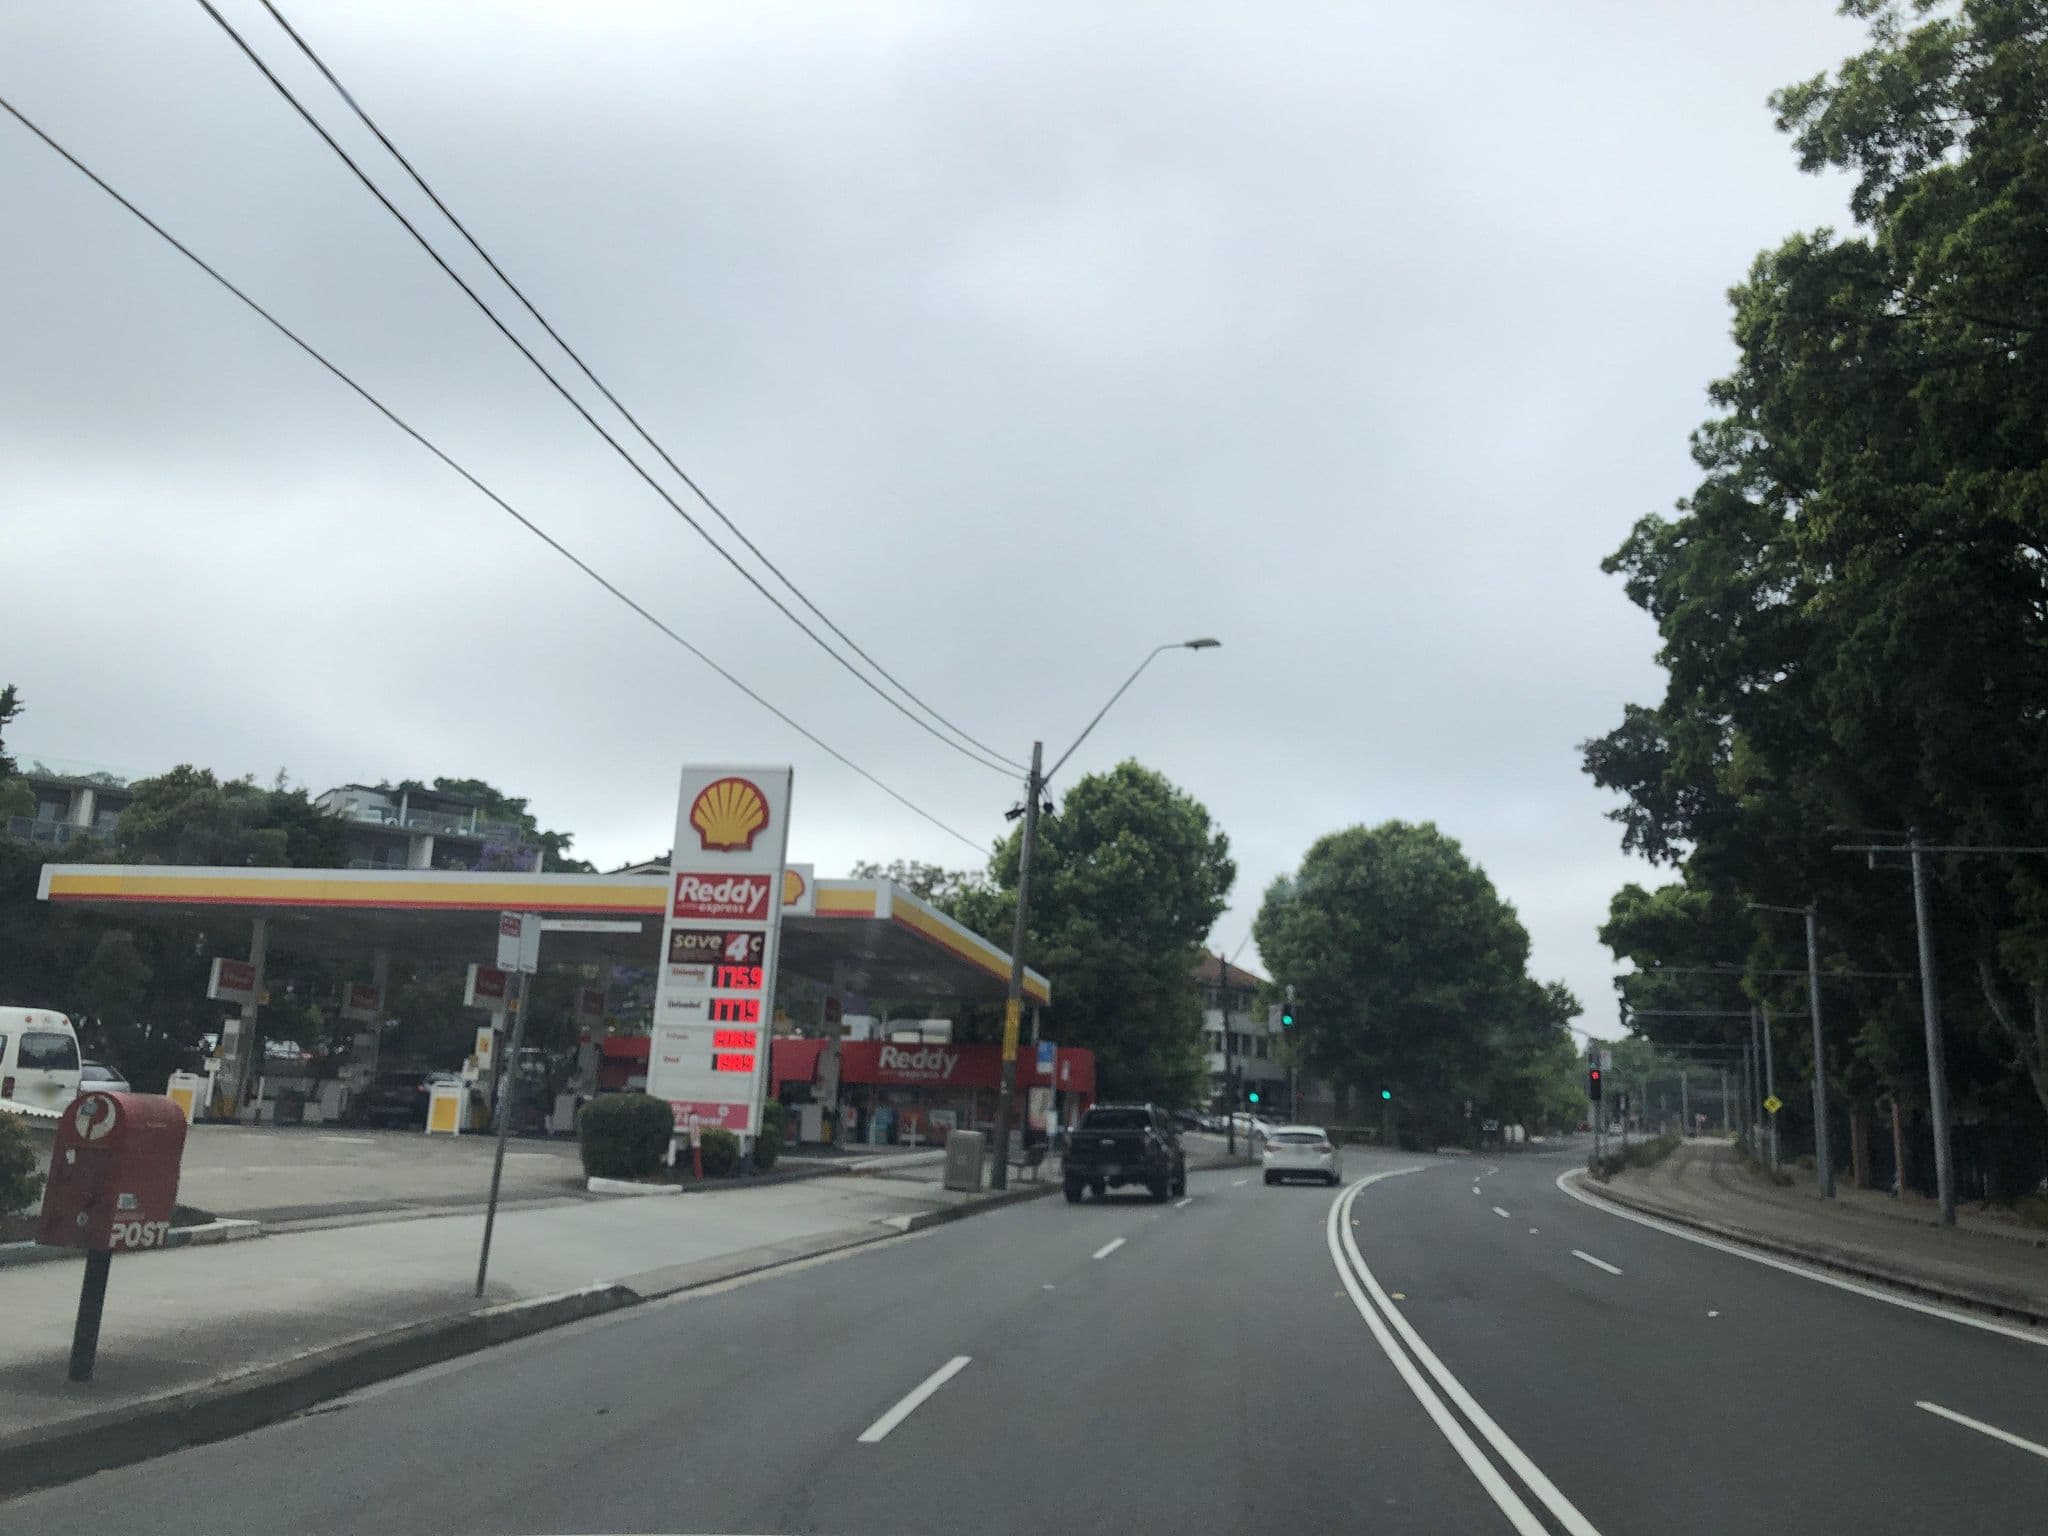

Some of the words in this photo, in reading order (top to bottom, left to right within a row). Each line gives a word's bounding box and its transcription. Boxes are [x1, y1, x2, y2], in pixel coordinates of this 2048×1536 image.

[678, 876, 767, 913] Reddy
[673, 934, 723, 950] save
[878, 1045, 959, 1079] Reddy
[109, 1220, 171, 1248] POST
